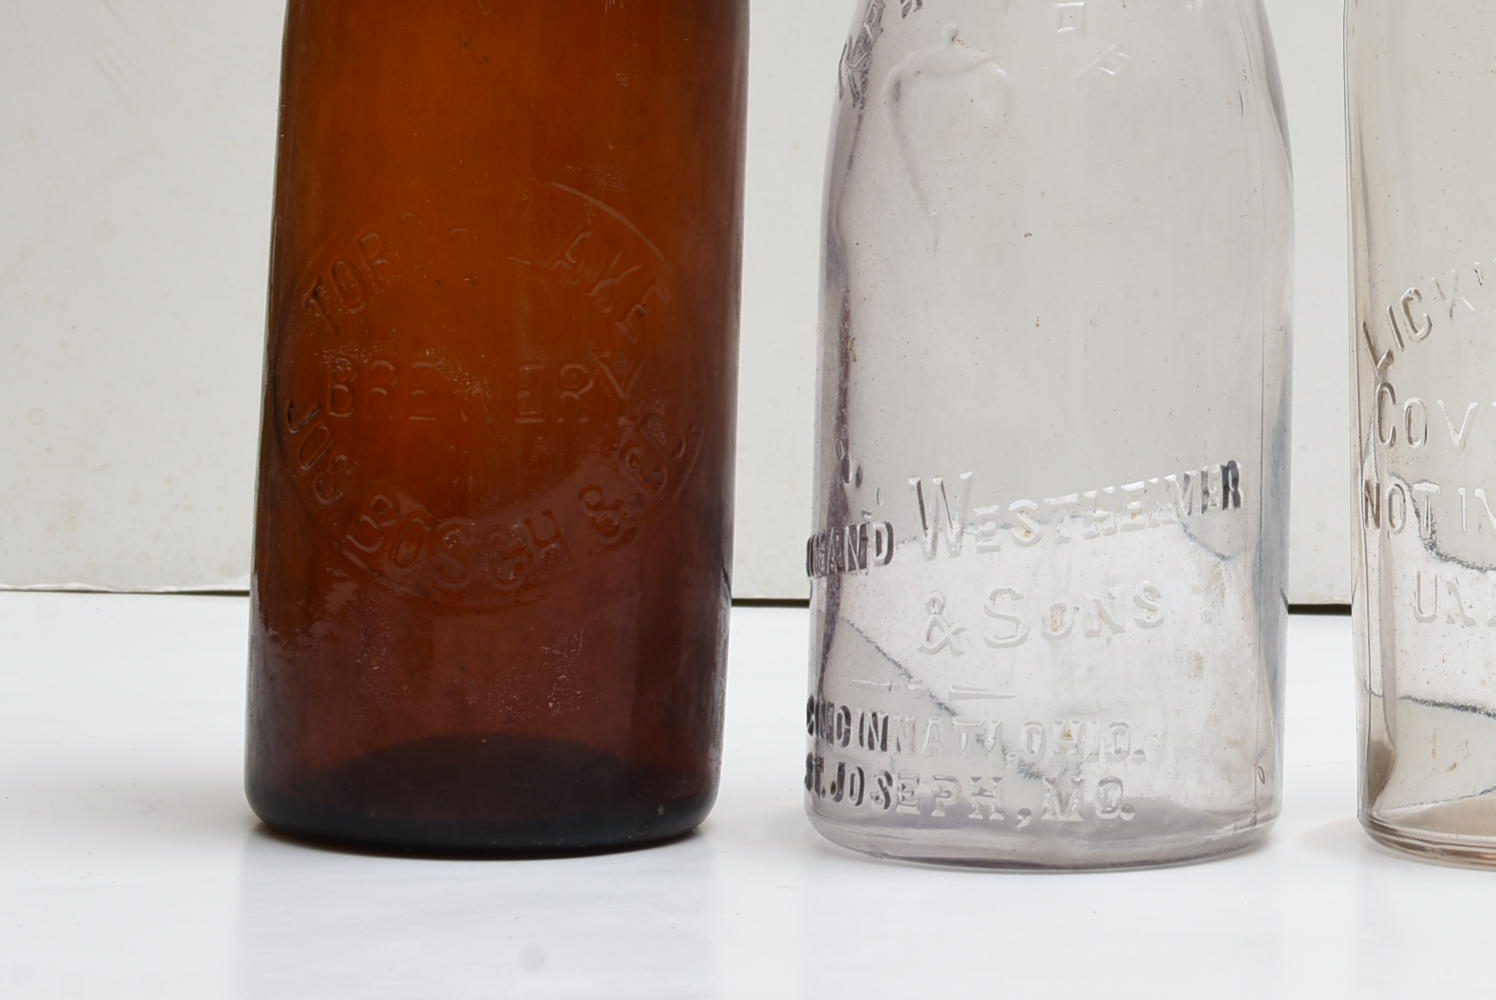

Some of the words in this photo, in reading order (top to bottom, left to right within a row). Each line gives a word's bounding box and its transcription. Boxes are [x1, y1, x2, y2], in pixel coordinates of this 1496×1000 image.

[1363, 479, 1441, 541] NOT
[917, 590, 969, 657] &
[983, 577, 1166, 651] SONS
